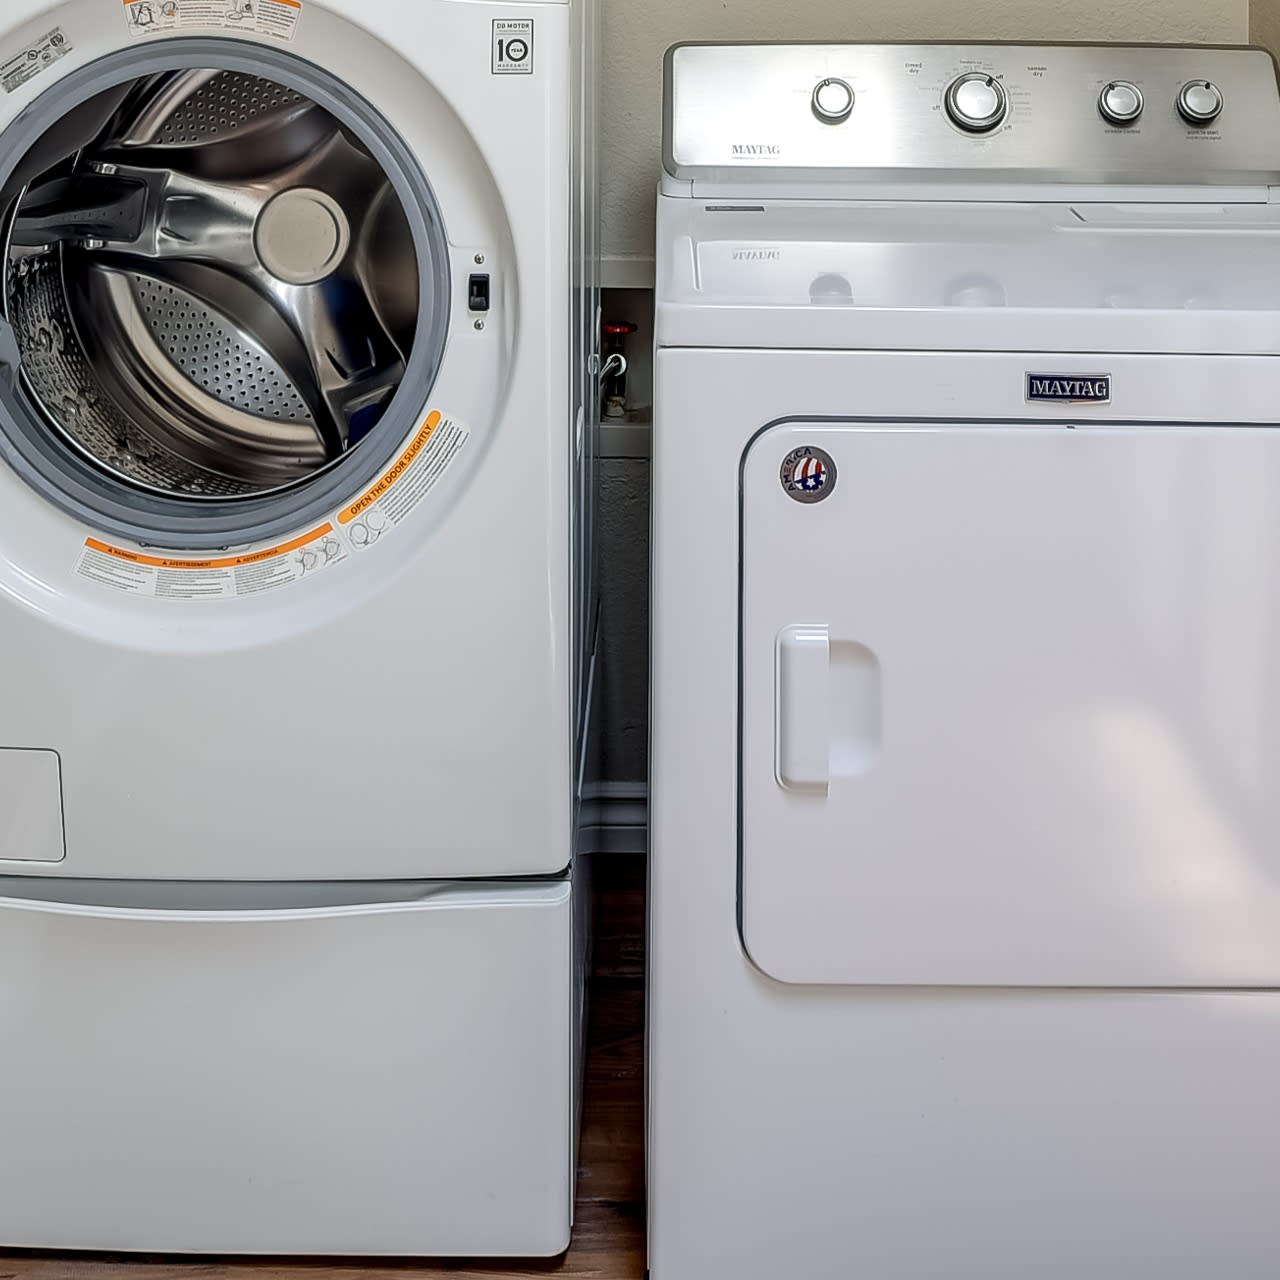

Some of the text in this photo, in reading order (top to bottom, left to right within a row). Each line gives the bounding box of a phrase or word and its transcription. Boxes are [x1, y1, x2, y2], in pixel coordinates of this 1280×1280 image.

[498, 38, 529, 62] 10
[731, 144, 780, 155] MAYTAG
[1031, 379, 1107, 397] MAYTAG
[350, 424, 433, 515] OPEN THE DOOR SLIGHTLY
